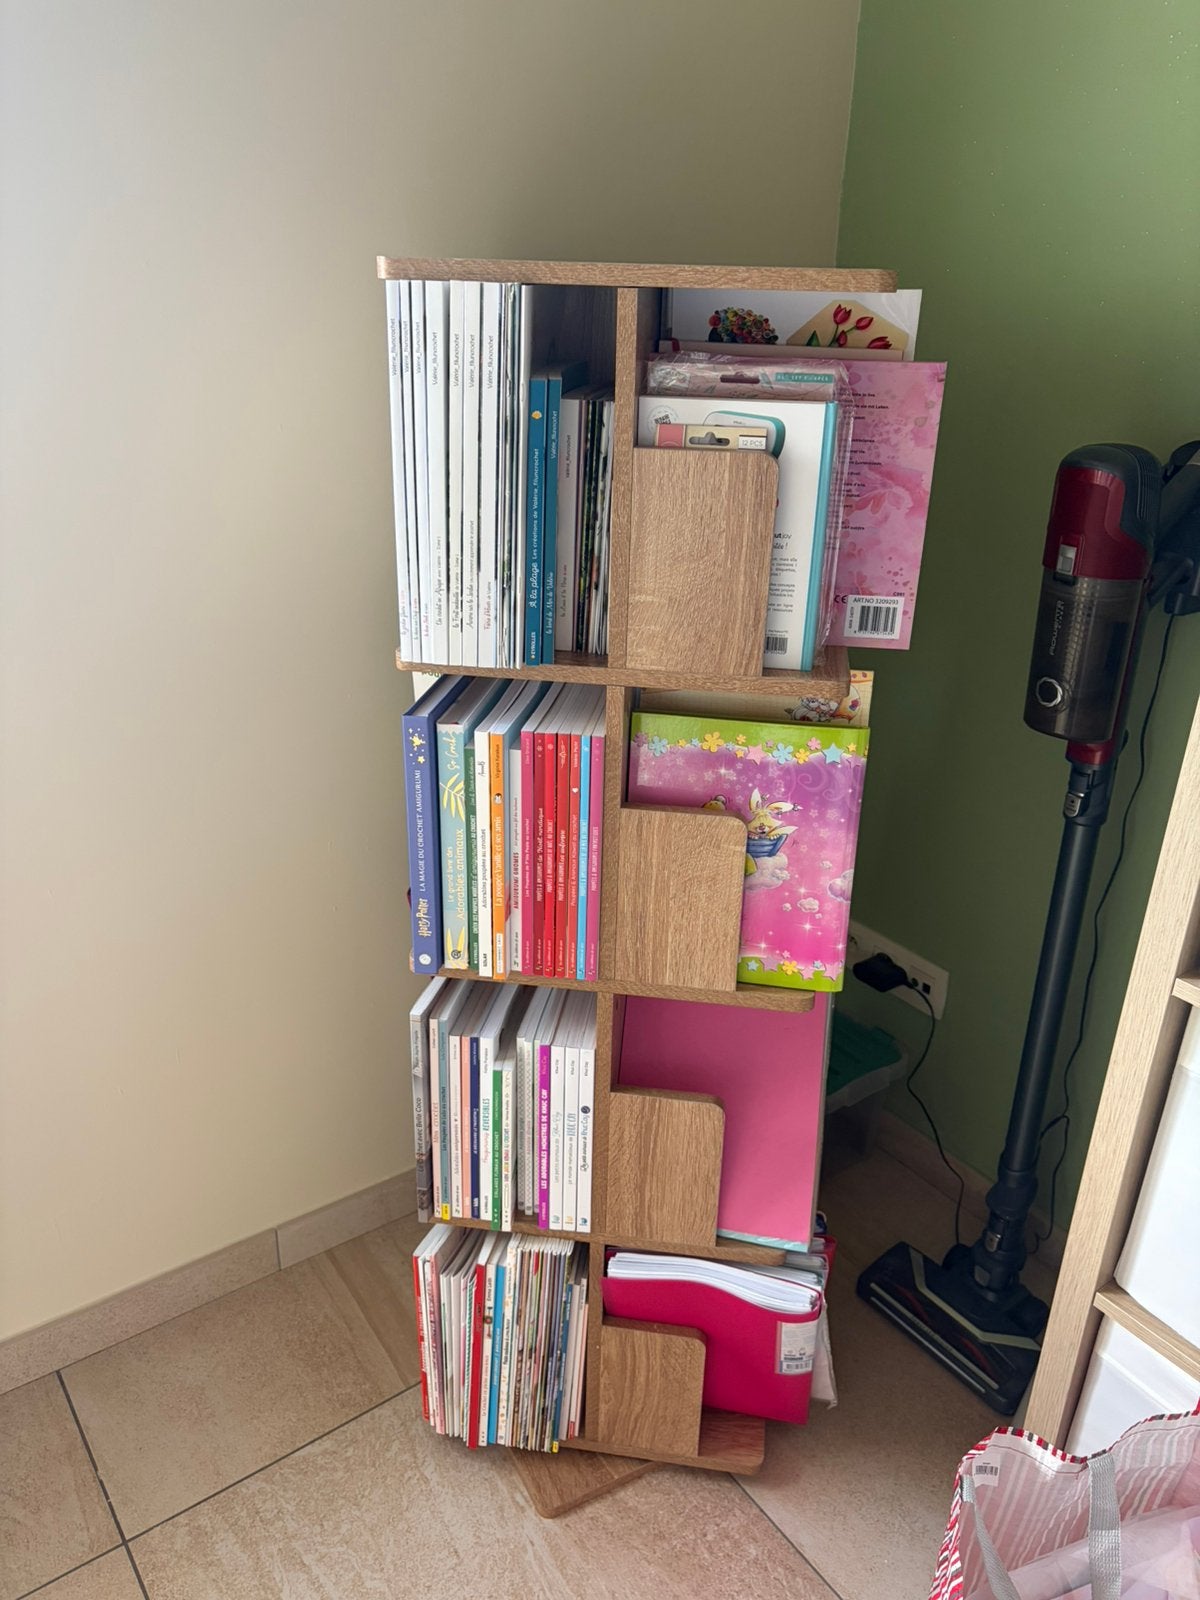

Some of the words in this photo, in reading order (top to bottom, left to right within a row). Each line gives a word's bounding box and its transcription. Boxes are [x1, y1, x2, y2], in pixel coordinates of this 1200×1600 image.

[529, 562, 539, 588] plage
[529, 589, 538, 599] la
[415, 769, 423, 813] AMIGURUMI
[416, 814, 424, 847] CROCHET
[493, 816, 501, 832] amis
[417, 848, 425, 859] DU
[445, 846, 454, 857] des
[455, 829, 465, 871] animaux
[446, 859, 454, 873] livre
[481, 859, 489, 881] poupées
[494, 852, 502, 873] Vanille
[419, 883, 426, 892] LA
[446, 874, 455, 894] grand
[494, 873, 504, 897] poupée
[446, 895, 454, 903] Le
[455, 873, 465, 920] Adorables
[495, 898, 502, 907] La
[415, 897, 431, 918] Potter
[417, 918, 432, 937] Harry
[415, 1113, 423, 1128] Bella
